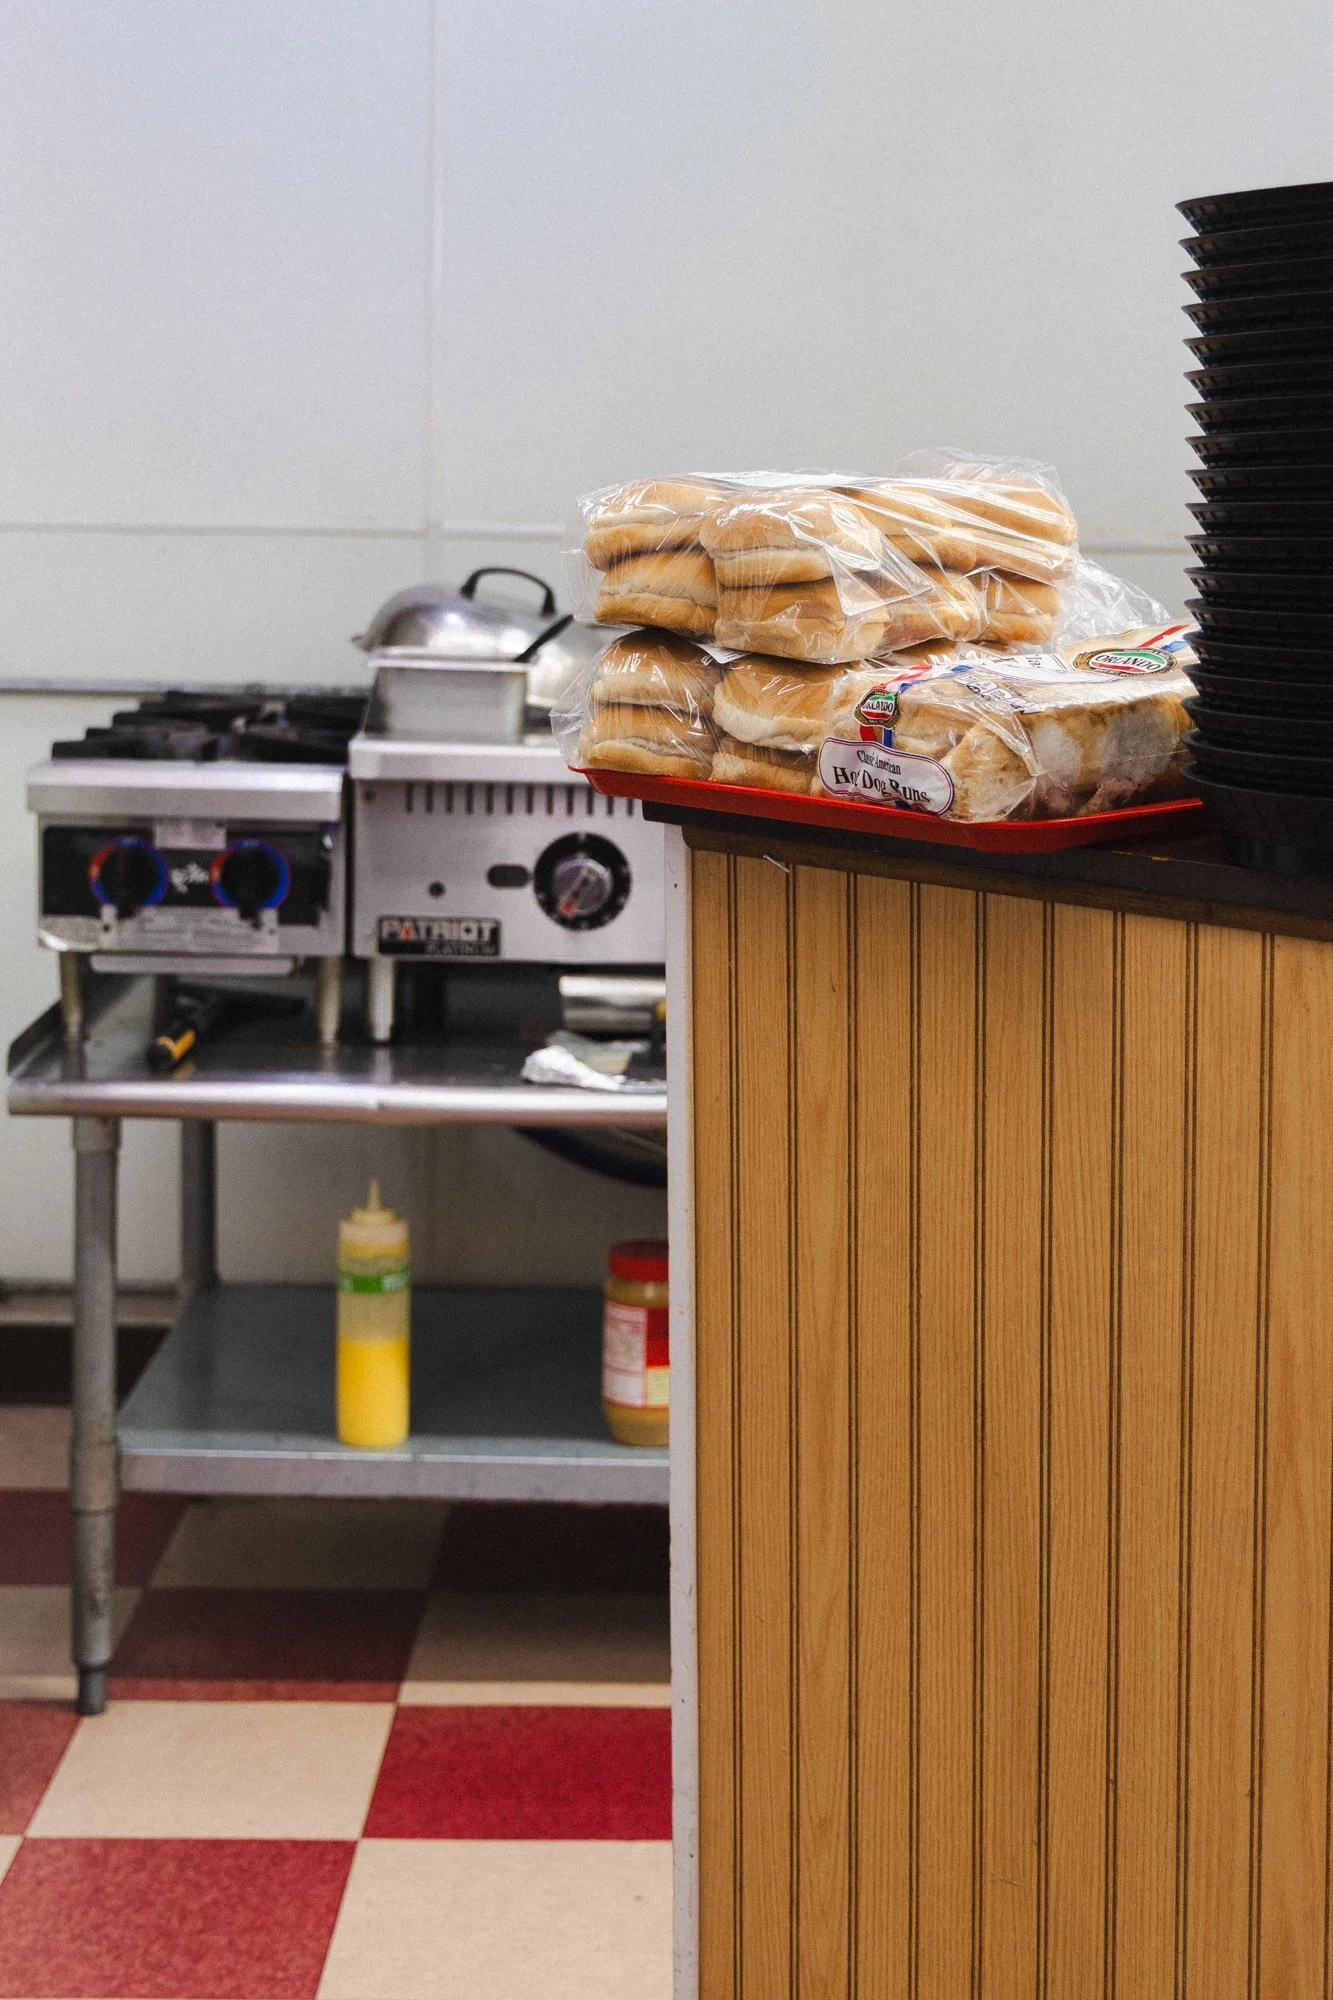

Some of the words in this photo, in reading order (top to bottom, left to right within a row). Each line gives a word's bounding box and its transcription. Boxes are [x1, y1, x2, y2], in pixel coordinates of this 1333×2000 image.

[1095, 654, 1161, 670] ORLANDO
[874, 755, 901, 775] American
[862, 770, 892, 797] Dog
[381, 920, 498, 940] PATRIOT
